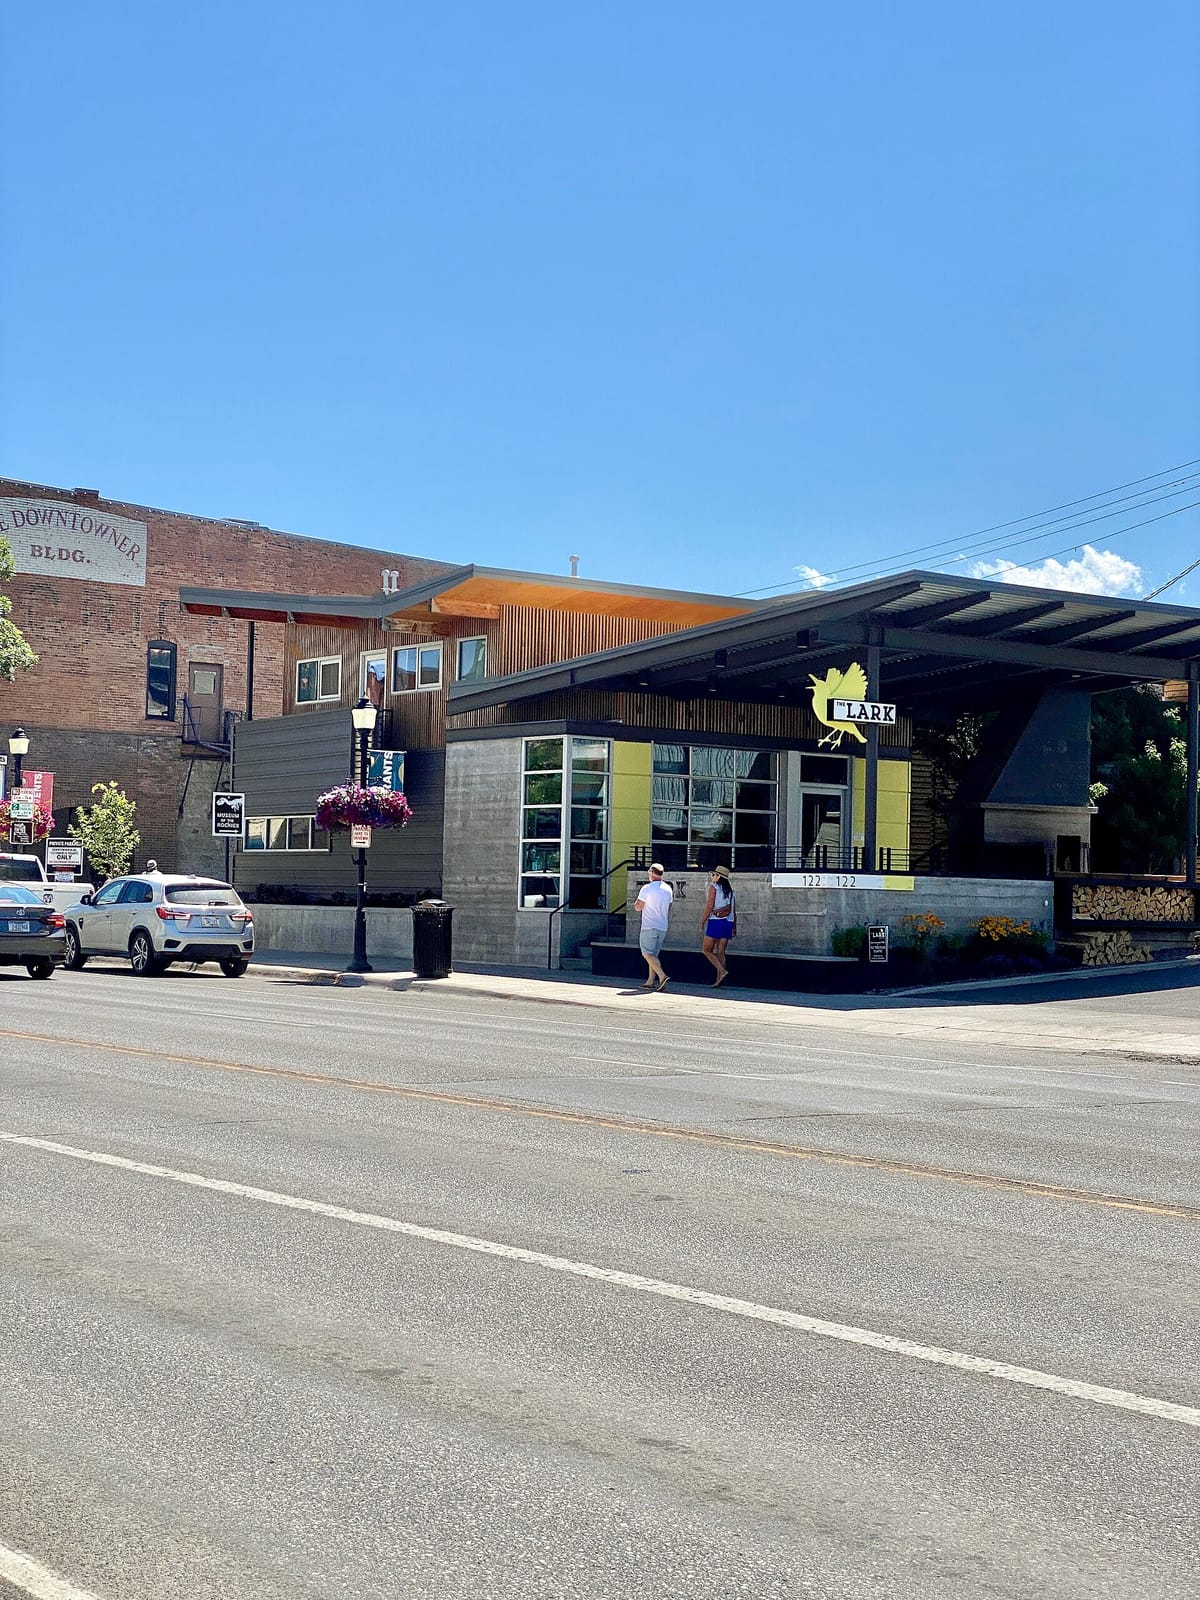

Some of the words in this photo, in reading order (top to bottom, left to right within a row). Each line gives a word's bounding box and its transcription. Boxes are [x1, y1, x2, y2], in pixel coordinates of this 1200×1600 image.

[11, 508, 141, 562] DOWNTOWNER
[30, 544, 92, 564] BLDG.
[846, 702, 895, 722] LARK
[802, 874, 821, 887] 122
[836, 875, 856, 888] 122
